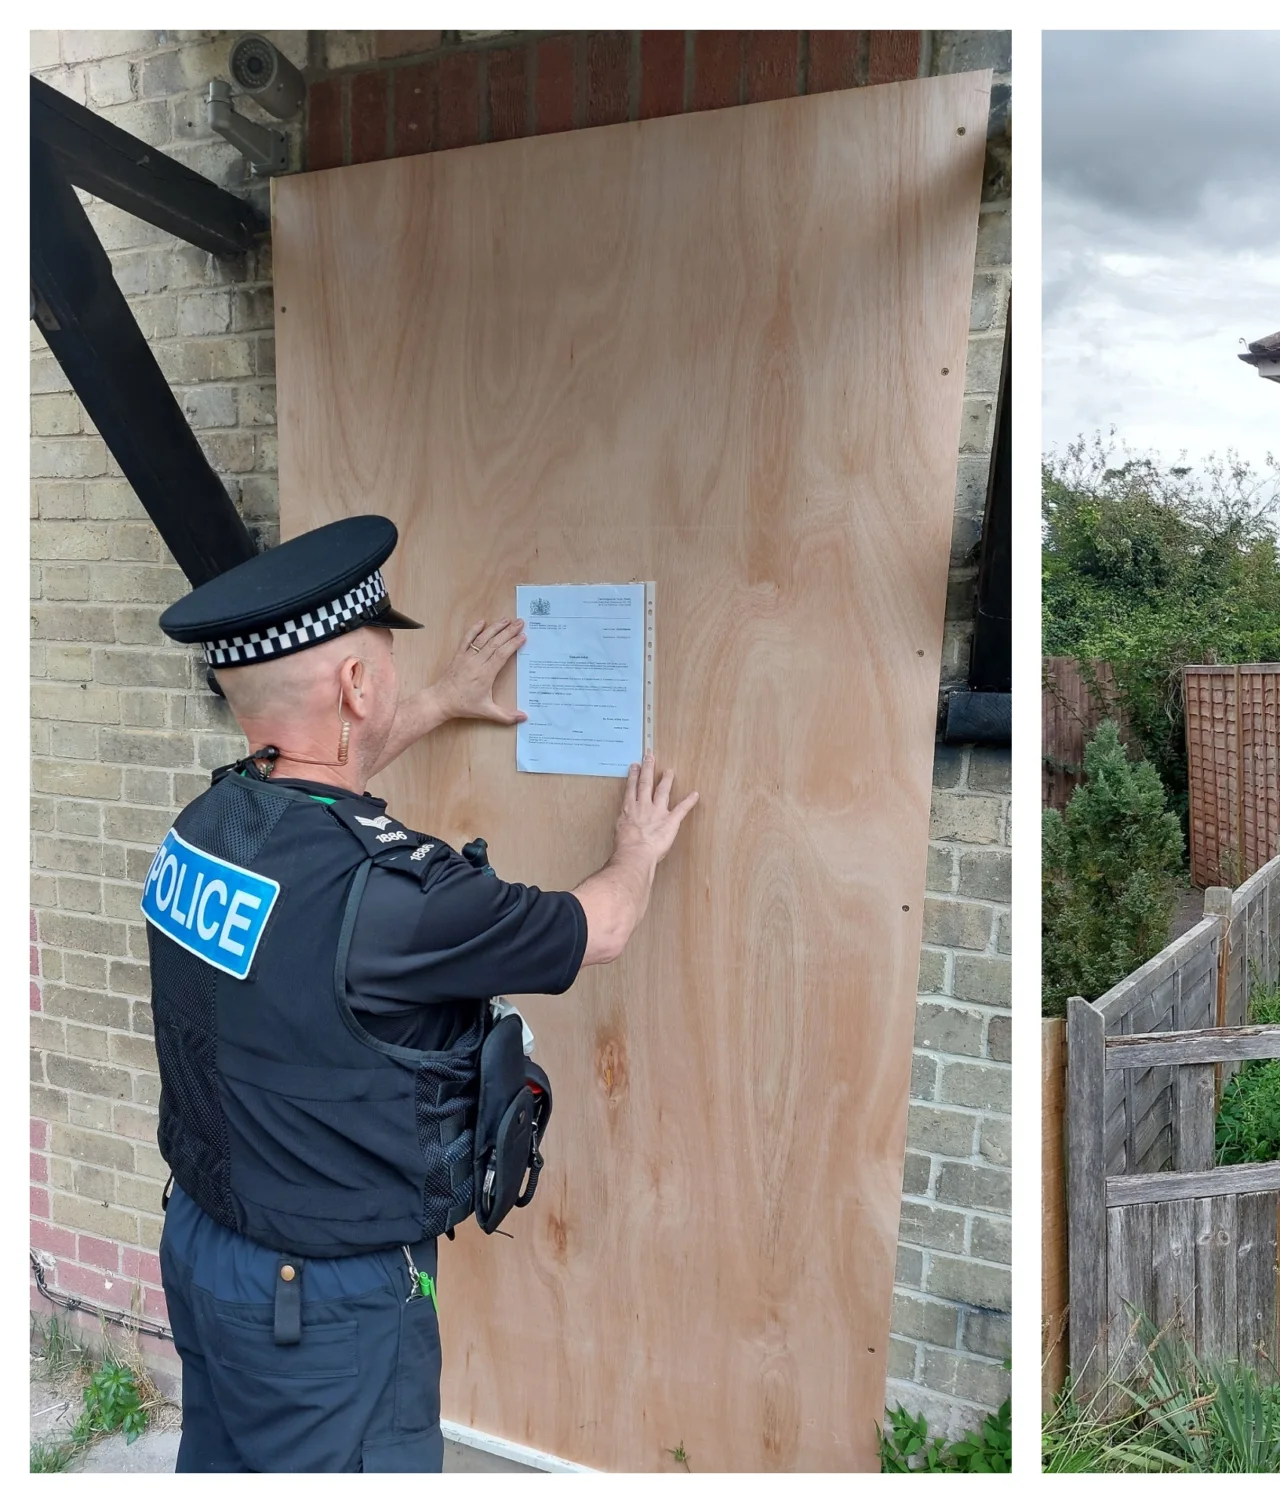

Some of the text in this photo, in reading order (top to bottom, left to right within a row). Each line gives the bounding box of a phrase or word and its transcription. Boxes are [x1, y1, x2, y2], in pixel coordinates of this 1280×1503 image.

[375, 831, 407, 843] 1886
[410, 844, 434, 861] 1886
[145, 845, 262, 957] POLICE
